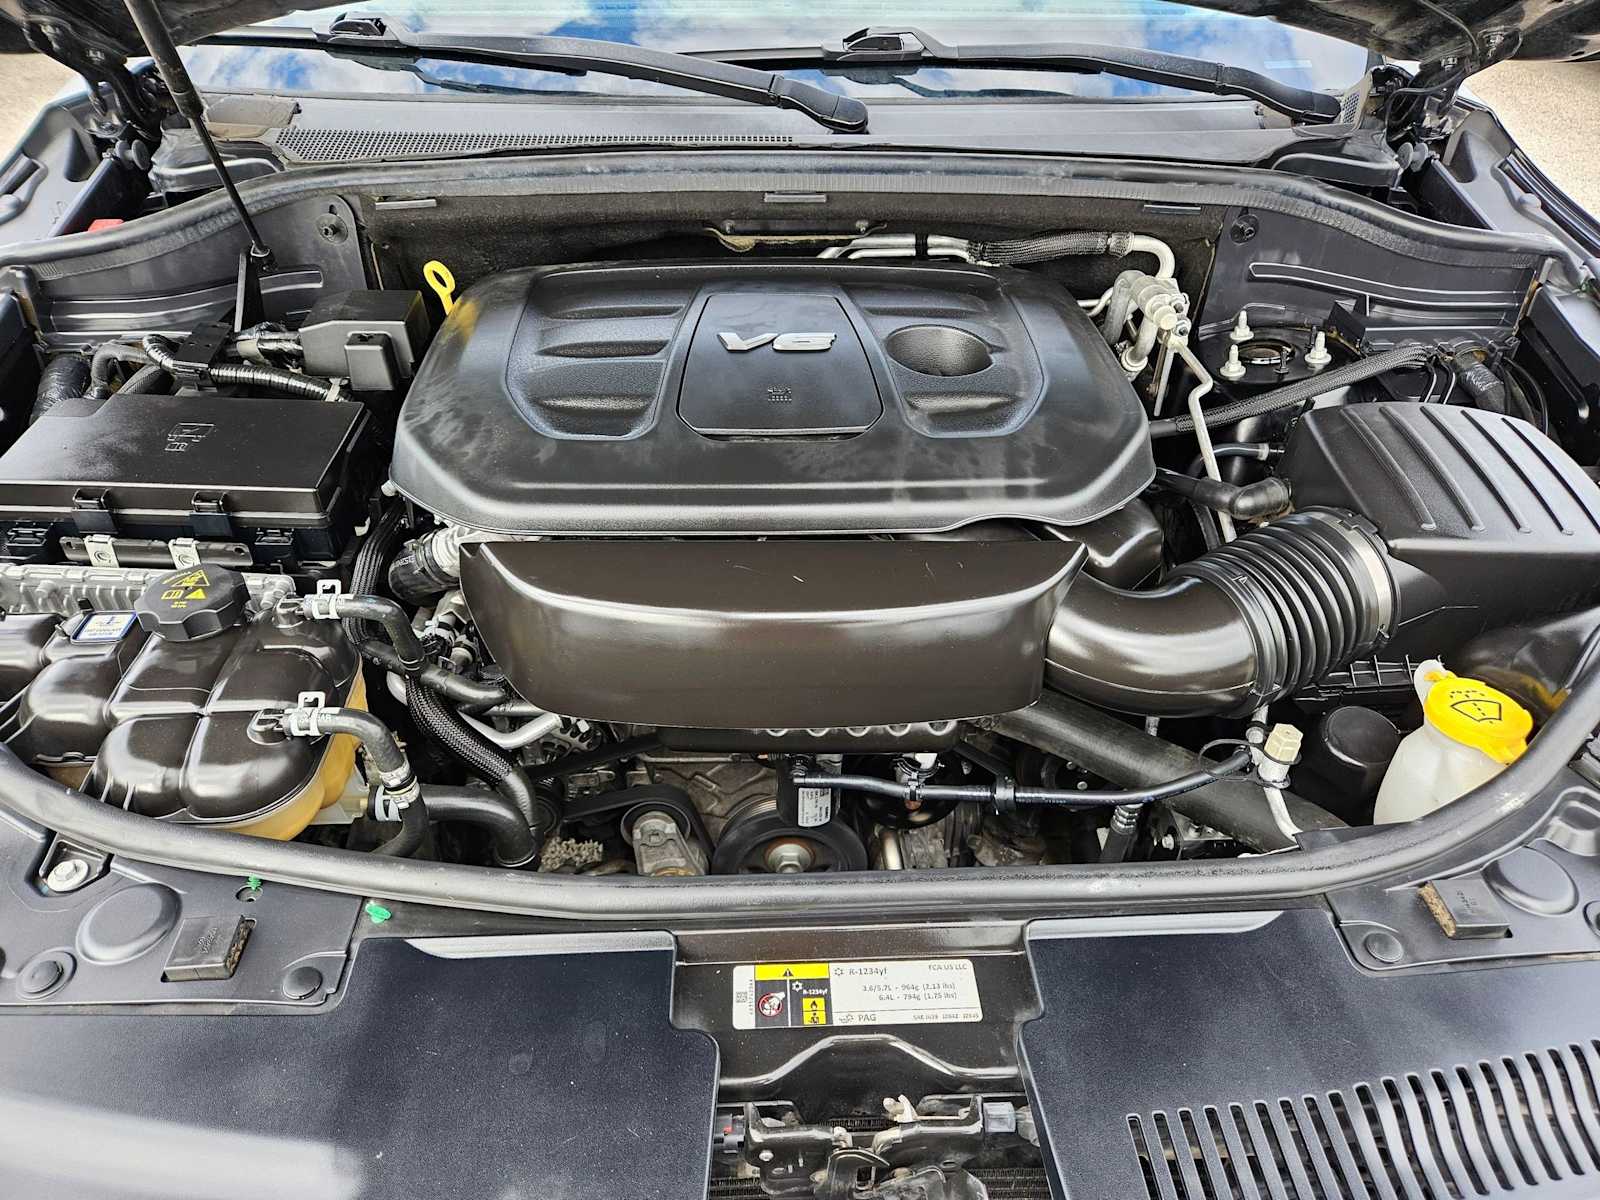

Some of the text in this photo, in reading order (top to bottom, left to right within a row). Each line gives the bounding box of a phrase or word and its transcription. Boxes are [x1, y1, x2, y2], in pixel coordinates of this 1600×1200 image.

[717, 332, 837, 353] V6
[944, 963, 954, 971] US
[848, 967, 887, 977] R-1234yf
[858, 1013, 877, 1022] PAG
